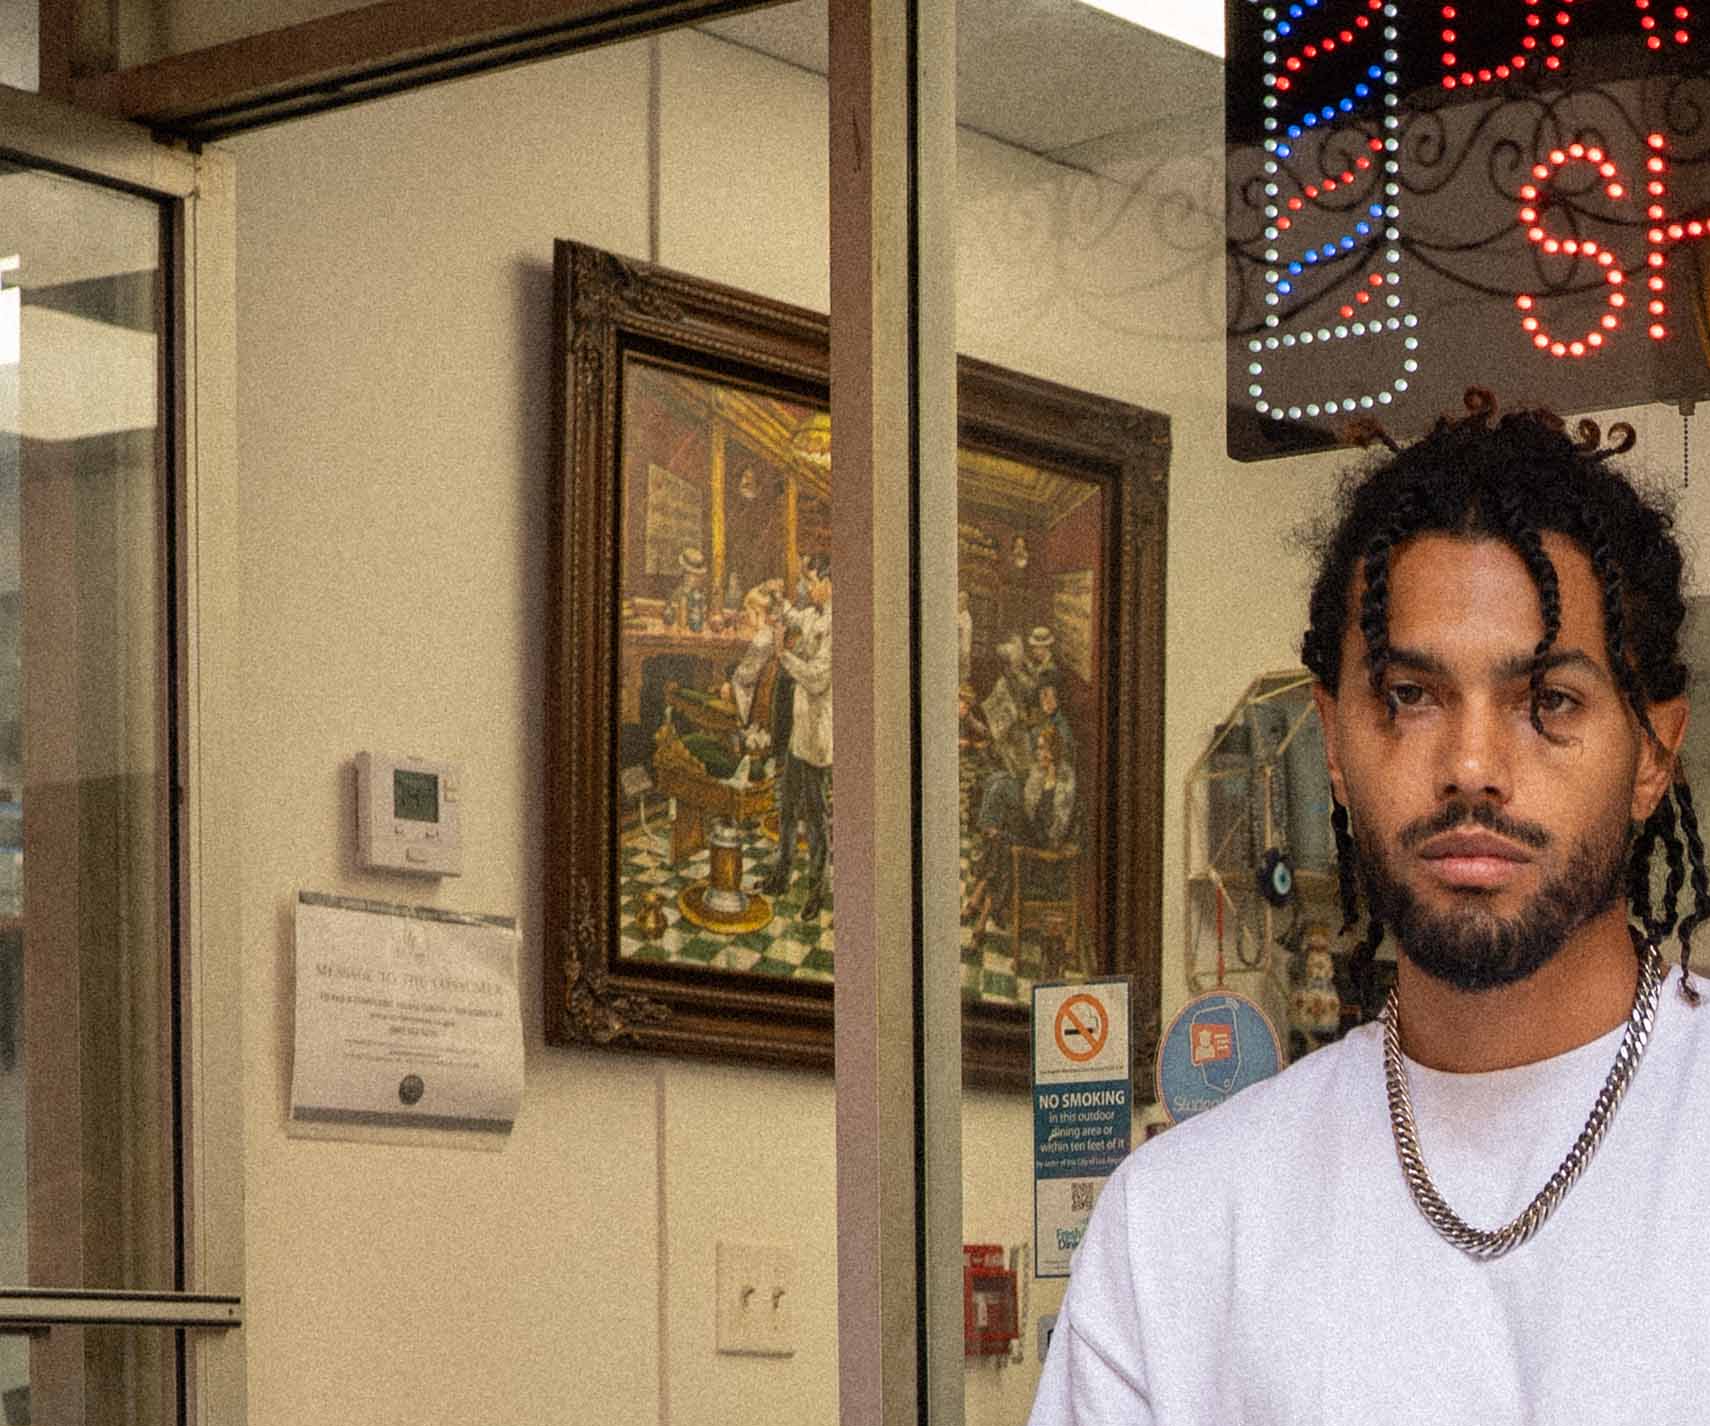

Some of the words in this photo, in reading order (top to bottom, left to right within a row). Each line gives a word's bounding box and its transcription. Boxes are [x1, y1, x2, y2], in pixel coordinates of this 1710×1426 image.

[1039, 1093, 1059, 1110] NO
[1062, 1090, 1125, 1109] SMOKING
[1060, 1110, 1077, 1121] this
[1078, 1109, 1115, 1121] outdoor
[1082, 1126, 1102, 1136] area
[1103, 1125, 1113, 1136] or
[1040, 1140, 1069, 1152] within
[1071, 1140, 1086, 1151] ten
[1087, 1138, 1104, 1151] feet
[1106, 1137, 1116, 1150] of
[1117, 1137, 1125, 1149] it
